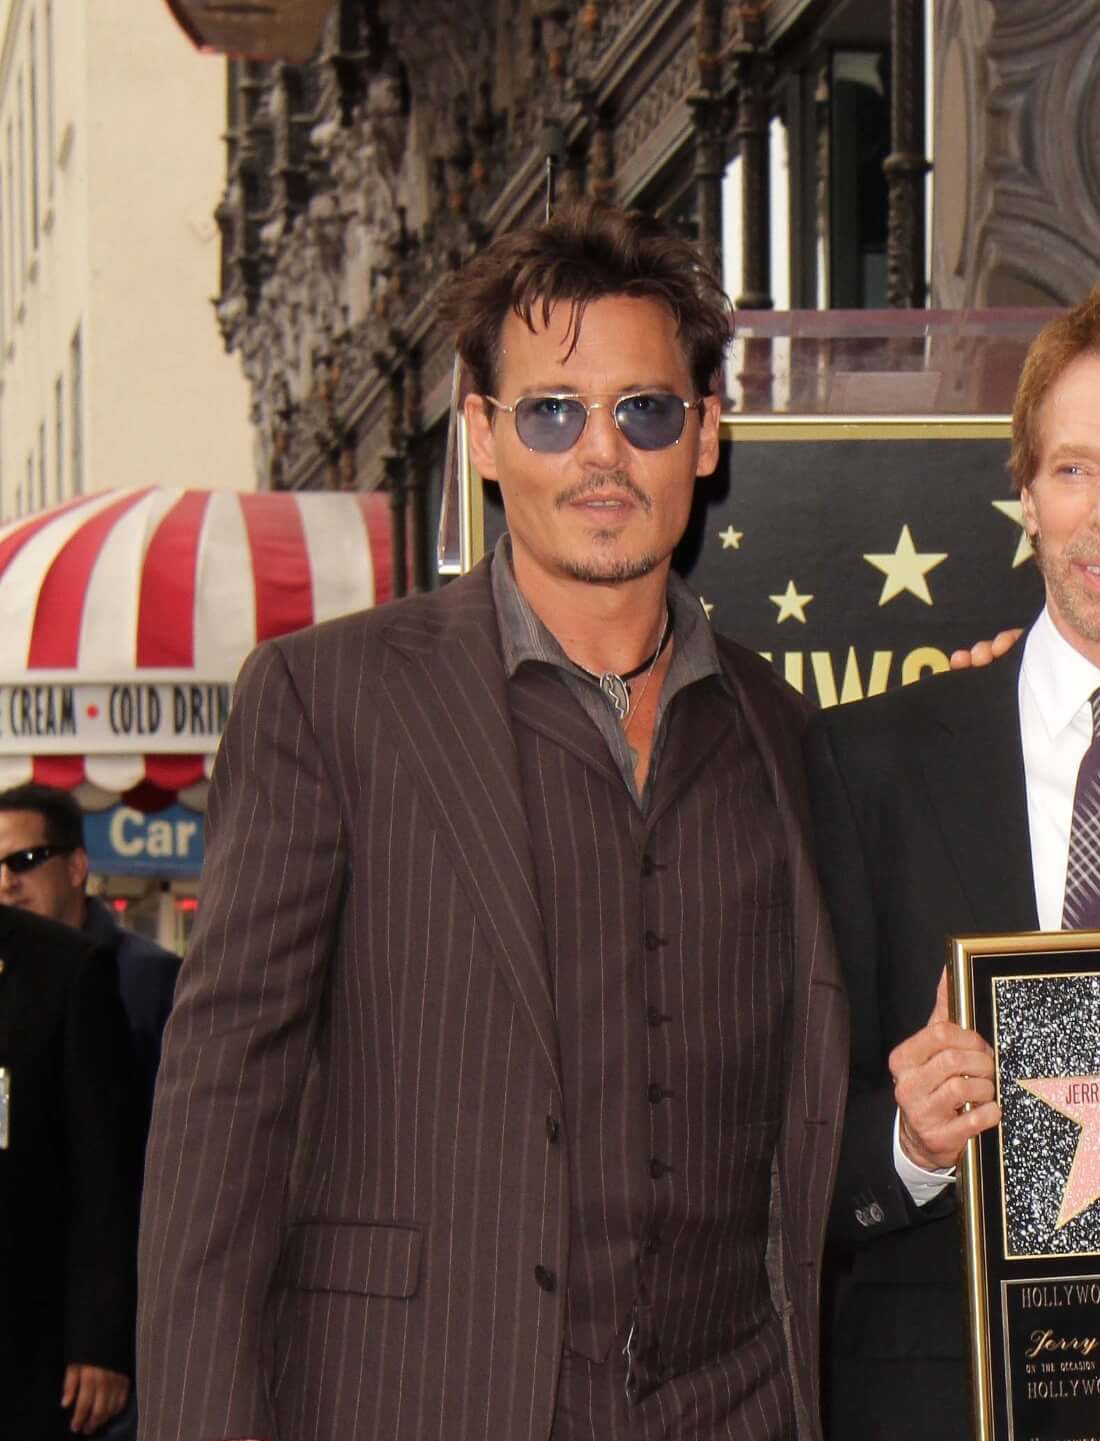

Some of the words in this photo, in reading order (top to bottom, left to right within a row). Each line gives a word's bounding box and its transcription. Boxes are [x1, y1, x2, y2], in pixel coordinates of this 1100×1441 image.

[10, 684, 77, 736] CREAM
[109, 683, 161, 735] COLD
[109, 807, 196, 857] Car
[1024, 1328, 1099, 1358] Jerry
[1041, 1362, 1056, 1373] THE
[1060, 1360, 1096, 1372] OCCASION
